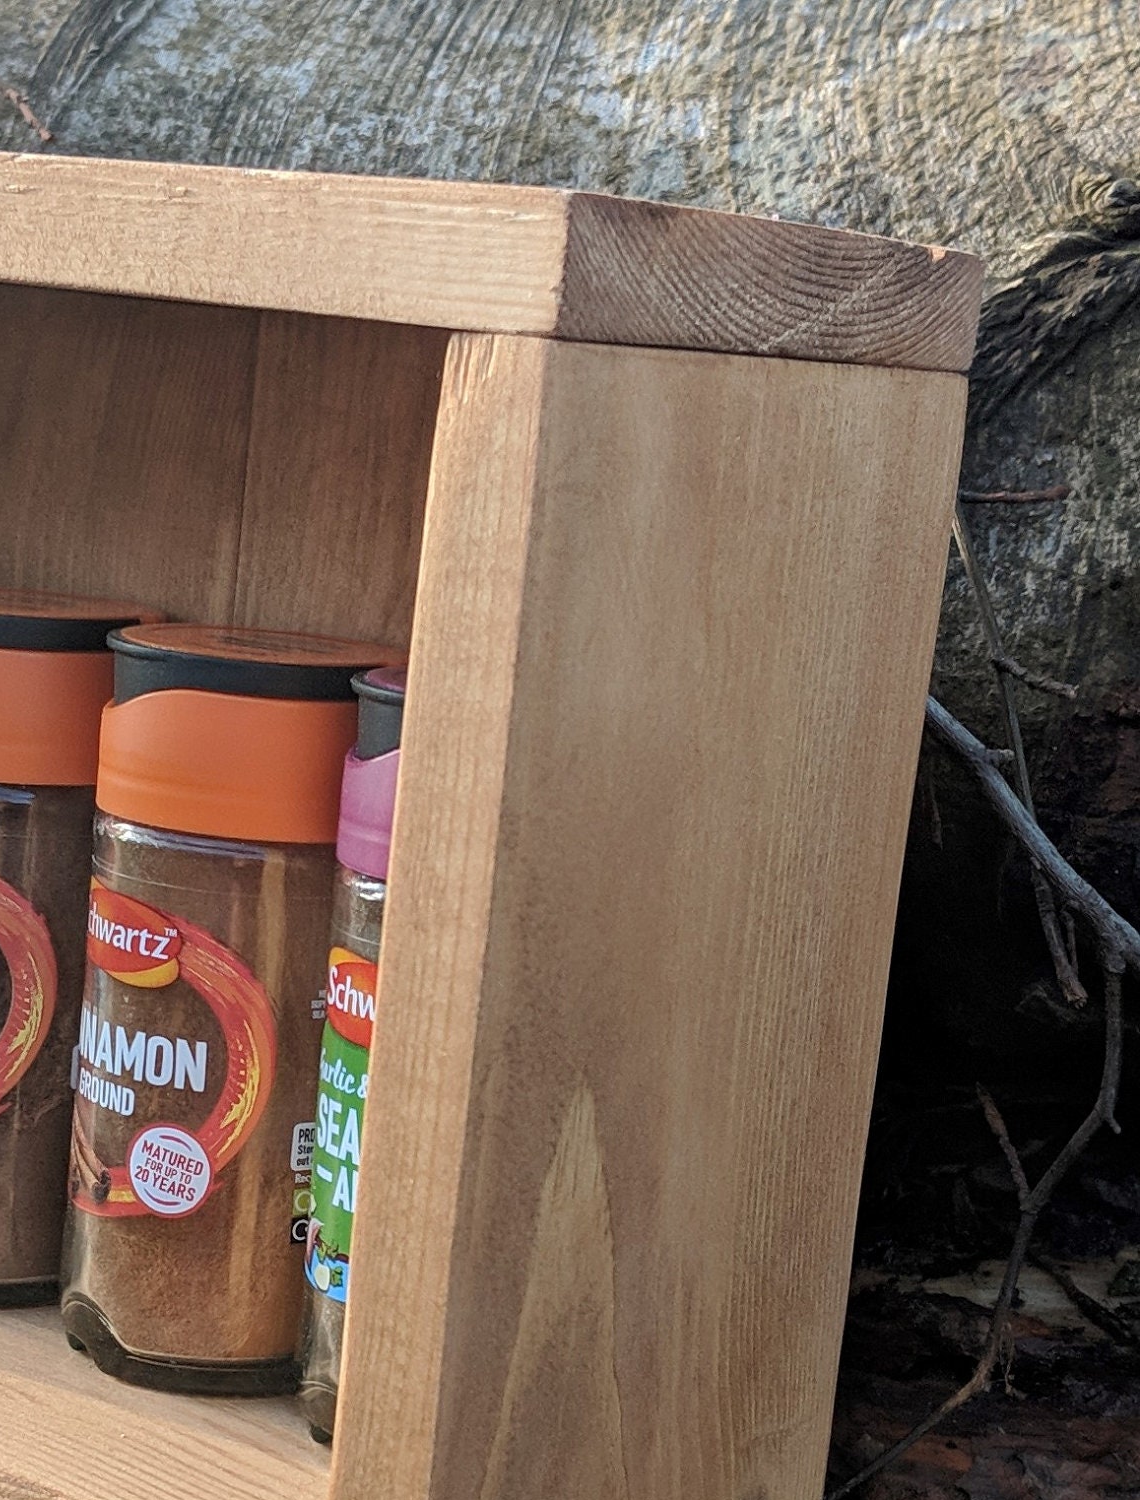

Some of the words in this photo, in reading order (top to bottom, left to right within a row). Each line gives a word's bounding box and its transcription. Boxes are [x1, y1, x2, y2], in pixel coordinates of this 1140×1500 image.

[86, 900, 169, 960] chwartz
[326, 964, 376, 1022] Schw
[78, 1066, 135, 1117] GROUND
[140, 1138, 205, 1177] MATURED
[144, 1157, 163, 1174] FOR
[163, 1163, 178, 1180] UP
[177, 1169, 192, 1186] TO
[133, 1165, 150, 1183] 20
[150, 1171, 197, 1202] YEARS
